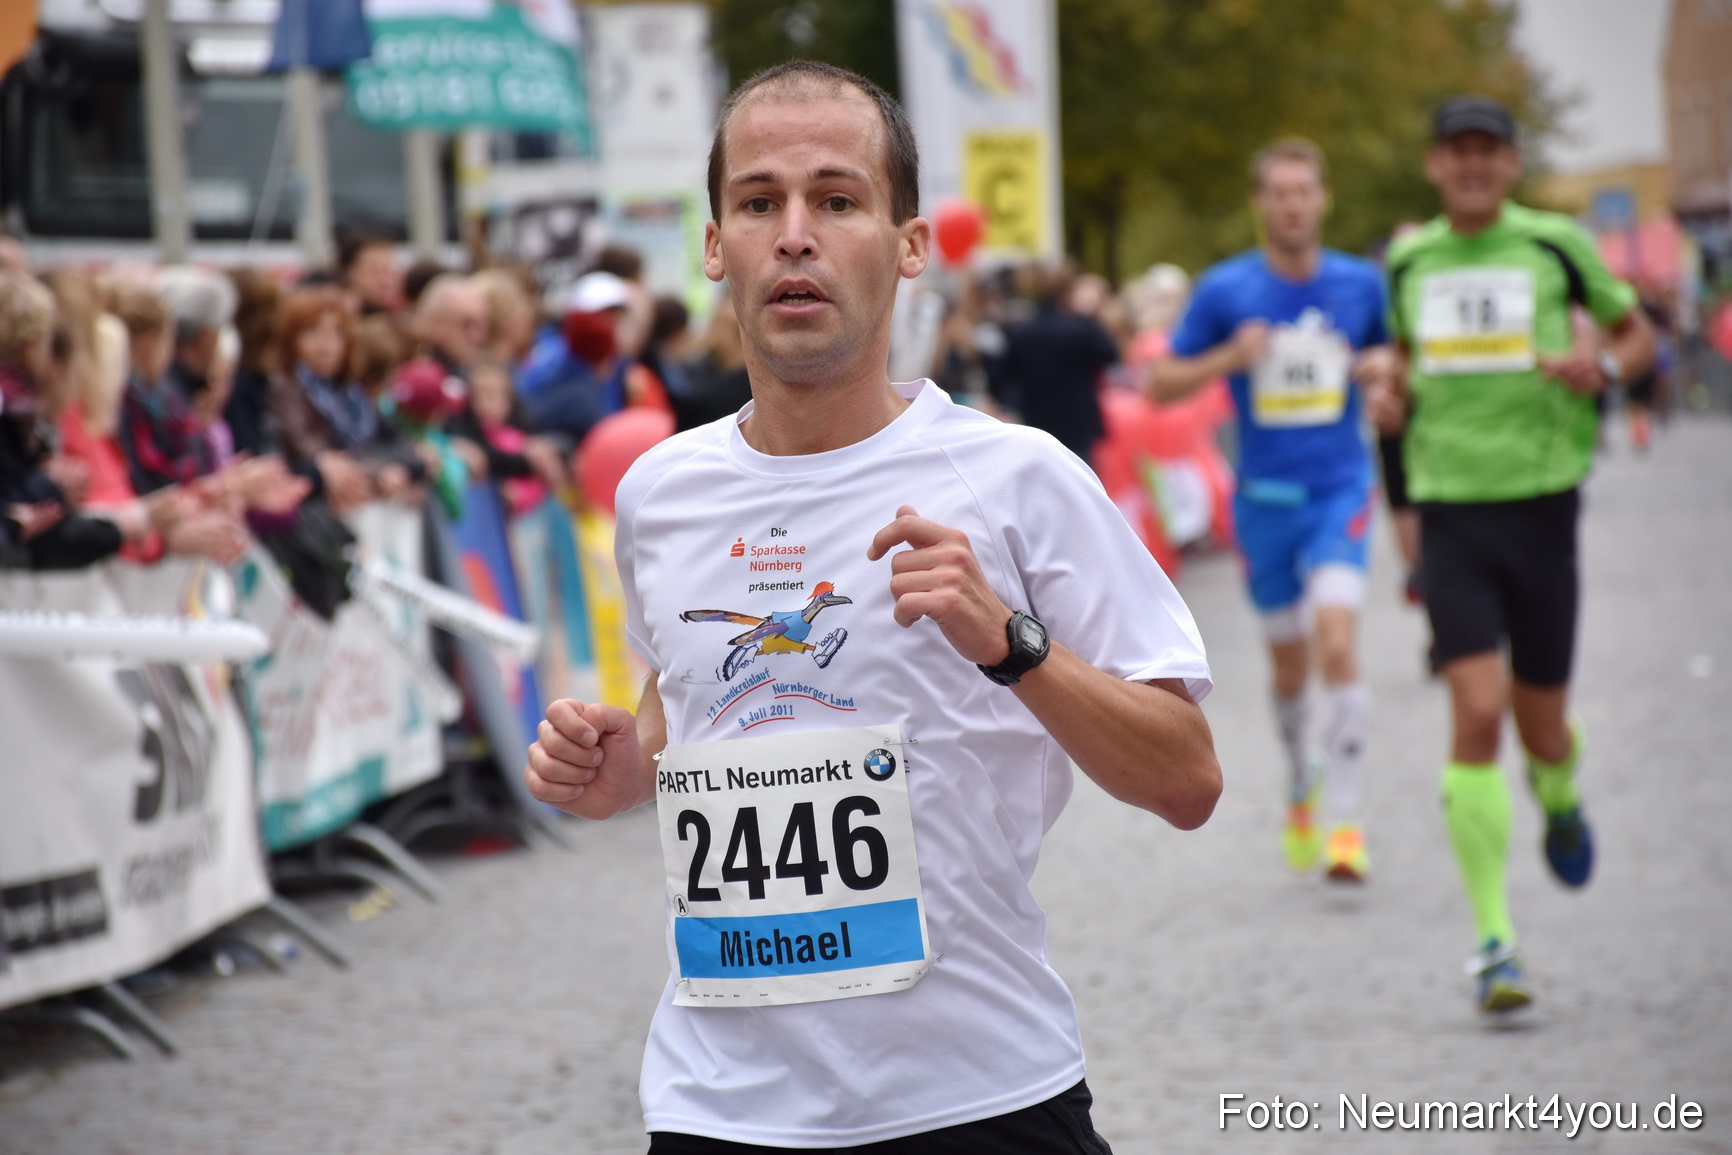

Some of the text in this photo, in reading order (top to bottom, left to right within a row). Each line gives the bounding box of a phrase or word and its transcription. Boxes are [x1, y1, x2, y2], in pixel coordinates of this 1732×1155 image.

[771, 527, 788, 538] Die
[750, 544, 806, 557] Sparkasse
[749, 561, 802, 573] Nürnberg
[748, 580, 805, 593] präsentiert
[706, 667, 772, 720] 12. Landkreislauf
[772, 682, 855, 707] Nürnberger Land
[738, 704, 794, 728] 9. Juli 2011
[866, 749, 893, 761] BMW
[659, 759, 853, 793] PARTL Neumarkt
[677, 795, 890, 903] 2446
[677, 897, 687, 914] A
[720, 922, 852, 968] Michael
